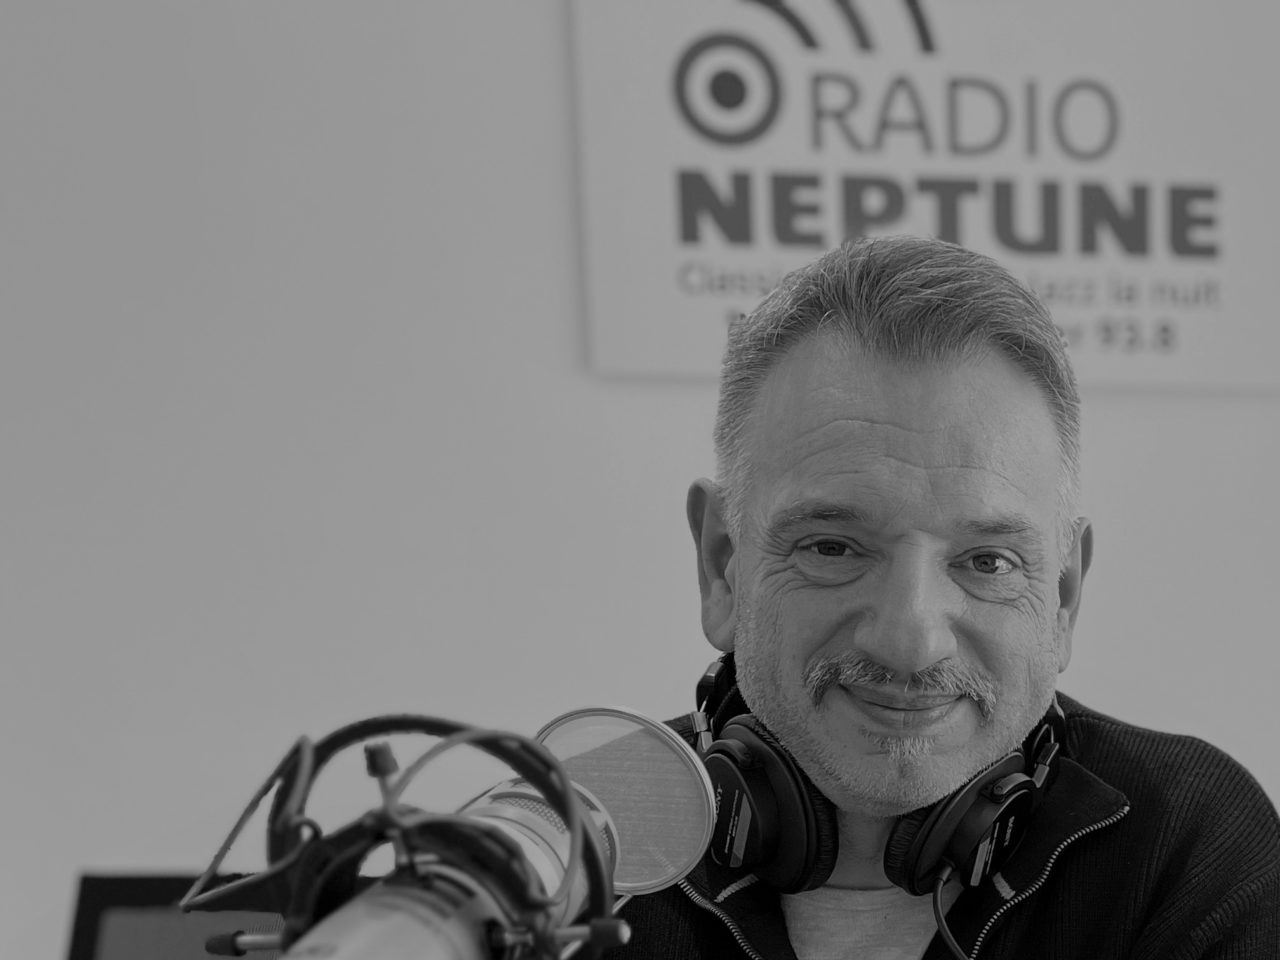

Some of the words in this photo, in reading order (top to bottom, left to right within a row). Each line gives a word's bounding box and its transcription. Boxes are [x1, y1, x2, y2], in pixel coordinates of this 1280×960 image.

[810, 71, 1120, 161] RADIO
[676, 169, 1220, 258] NEPTUNE
[676, 263, 771, 298] Class
